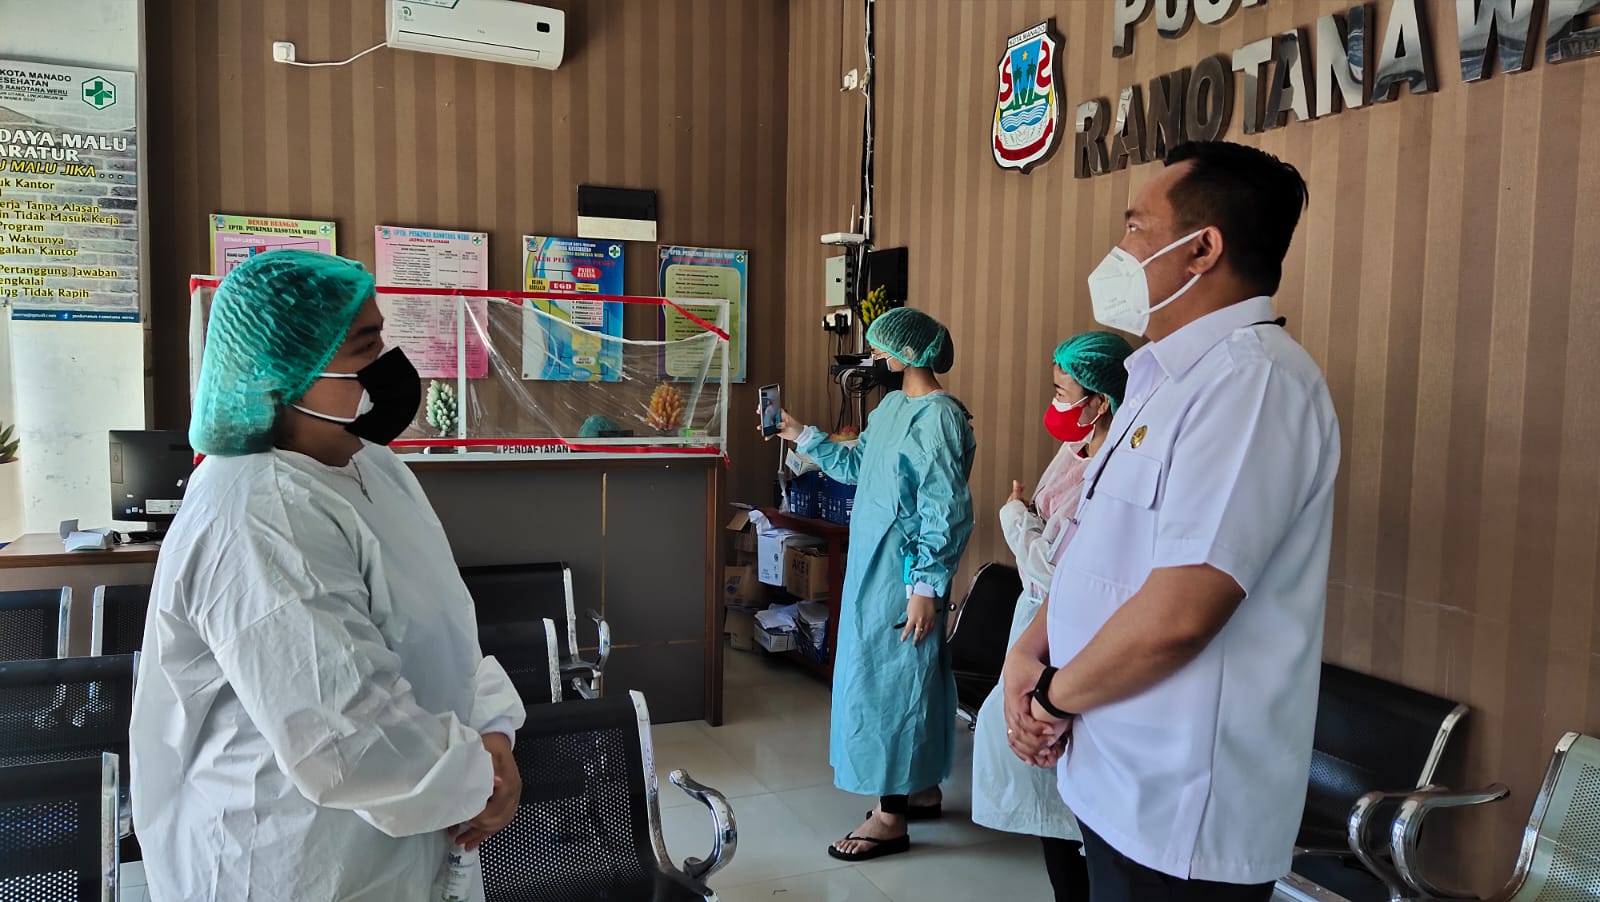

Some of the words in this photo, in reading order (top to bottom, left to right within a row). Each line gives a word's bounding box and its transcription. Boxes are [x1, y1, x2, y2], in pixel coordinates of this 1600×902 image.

[28, 72, 72, 82] MANADO
[5, 85, 45, 93] RANOTANA
[1074, 0, 1436, 178] RANOTANA
[62, 133, 127, 151] MALU
[10, 160, 57, 174] MALU
[60, 163, 96, 177] JIKA
[15, 178, 55, 190] Kantor
[25, 200, 59, 212] Tanpa
[62, 203, 100, 213] Alasan
[14, 211, 46, 221] Tidak
[50, 213, 87, 223] Masuk
[92, 215, 119, 226] Kerja
[9, 233, 64, 245] Waktunya
[40, 246, 78, 257] Kantor
[72, 266, 117, 278] Jawaban
[23, 287, 54, 297] Tidak
[58, 288, 89, 299] Rapih
[502, 445, 569, 454] PENDAFTARAN
